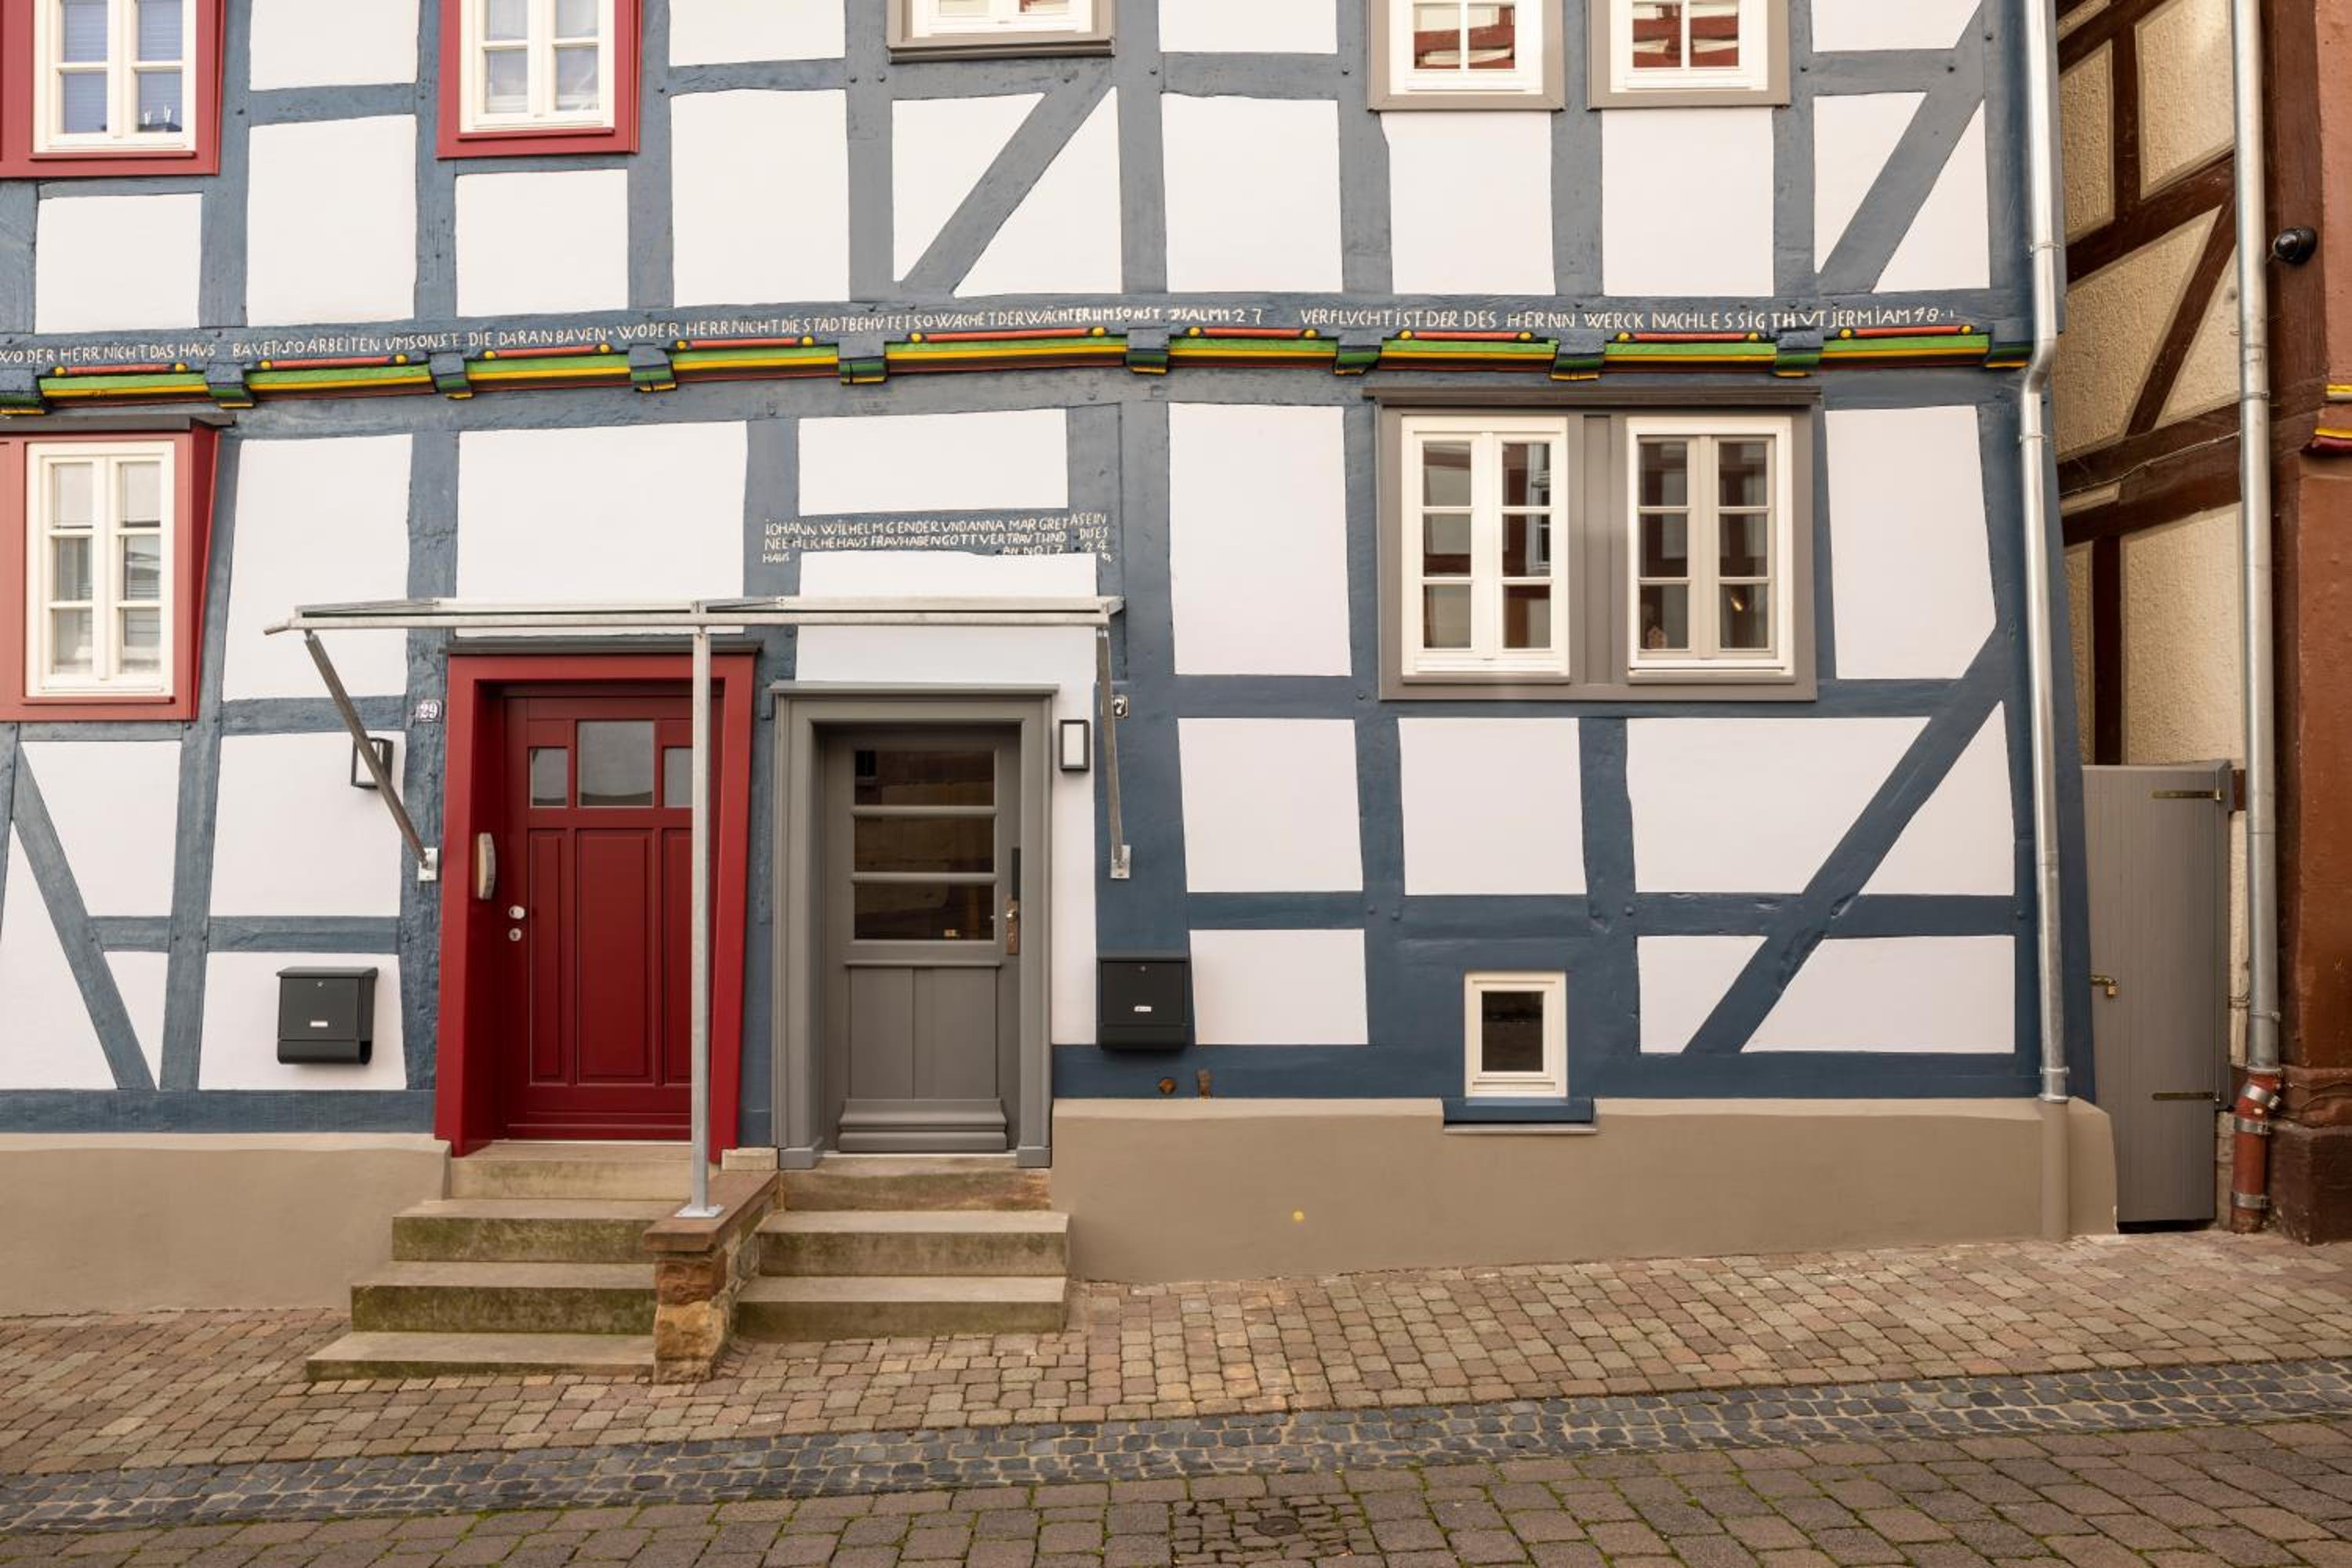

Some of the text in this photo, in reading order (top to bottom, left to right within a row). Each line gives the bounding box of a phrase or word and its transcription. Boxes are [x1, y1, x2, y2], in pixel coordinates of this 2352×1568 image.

[1426, 310, 1457, 327] DER
[1464, 310, 1496, 328] DES
[1584, 312, 1644, 328] WERCK
[60, 346, 100, 361] HERR
[150, 343, 175, 358] DAS
[686, 320, 729, 336] HERR
[419, 702, 439, 719] 29
